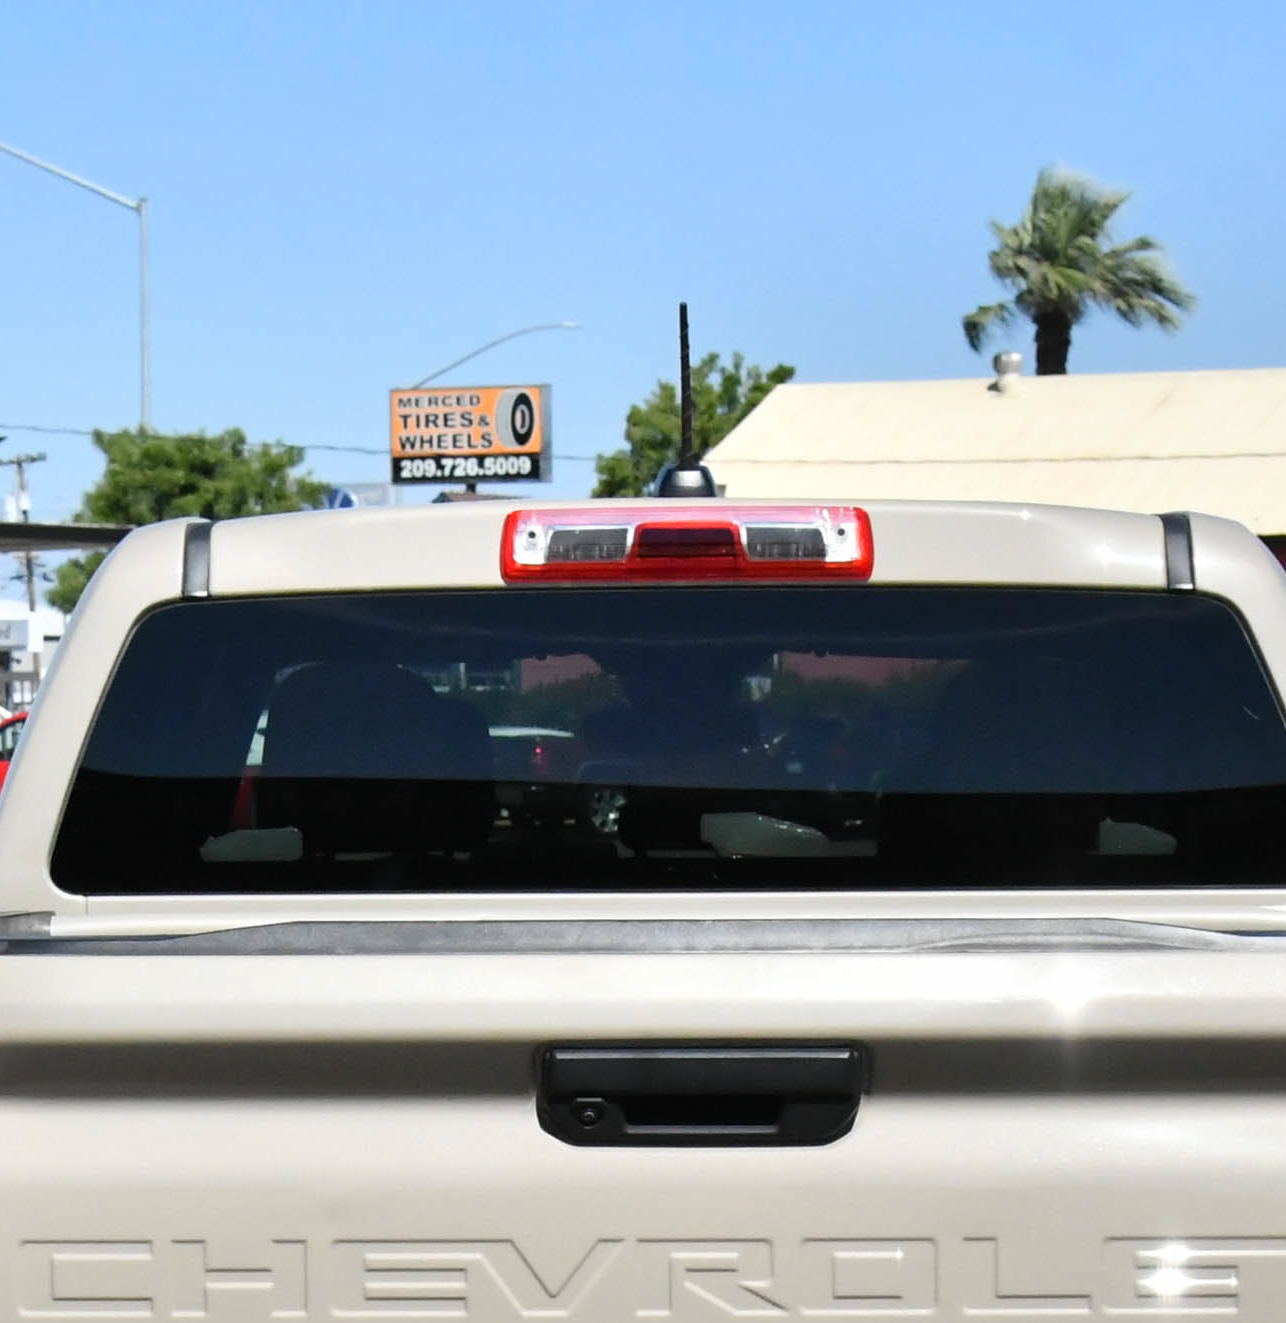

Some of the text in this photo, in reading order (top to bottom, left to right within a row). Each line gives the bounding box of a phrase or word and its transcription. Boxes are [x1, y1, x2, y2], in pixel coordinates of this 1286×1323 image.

[398, 394, 481, 409] MERCED
[399, 411, 491, 430] TIRES &
[399, 432, 494, 451] WHEELS
[400, 455, 532, 479] 209.726.5009
